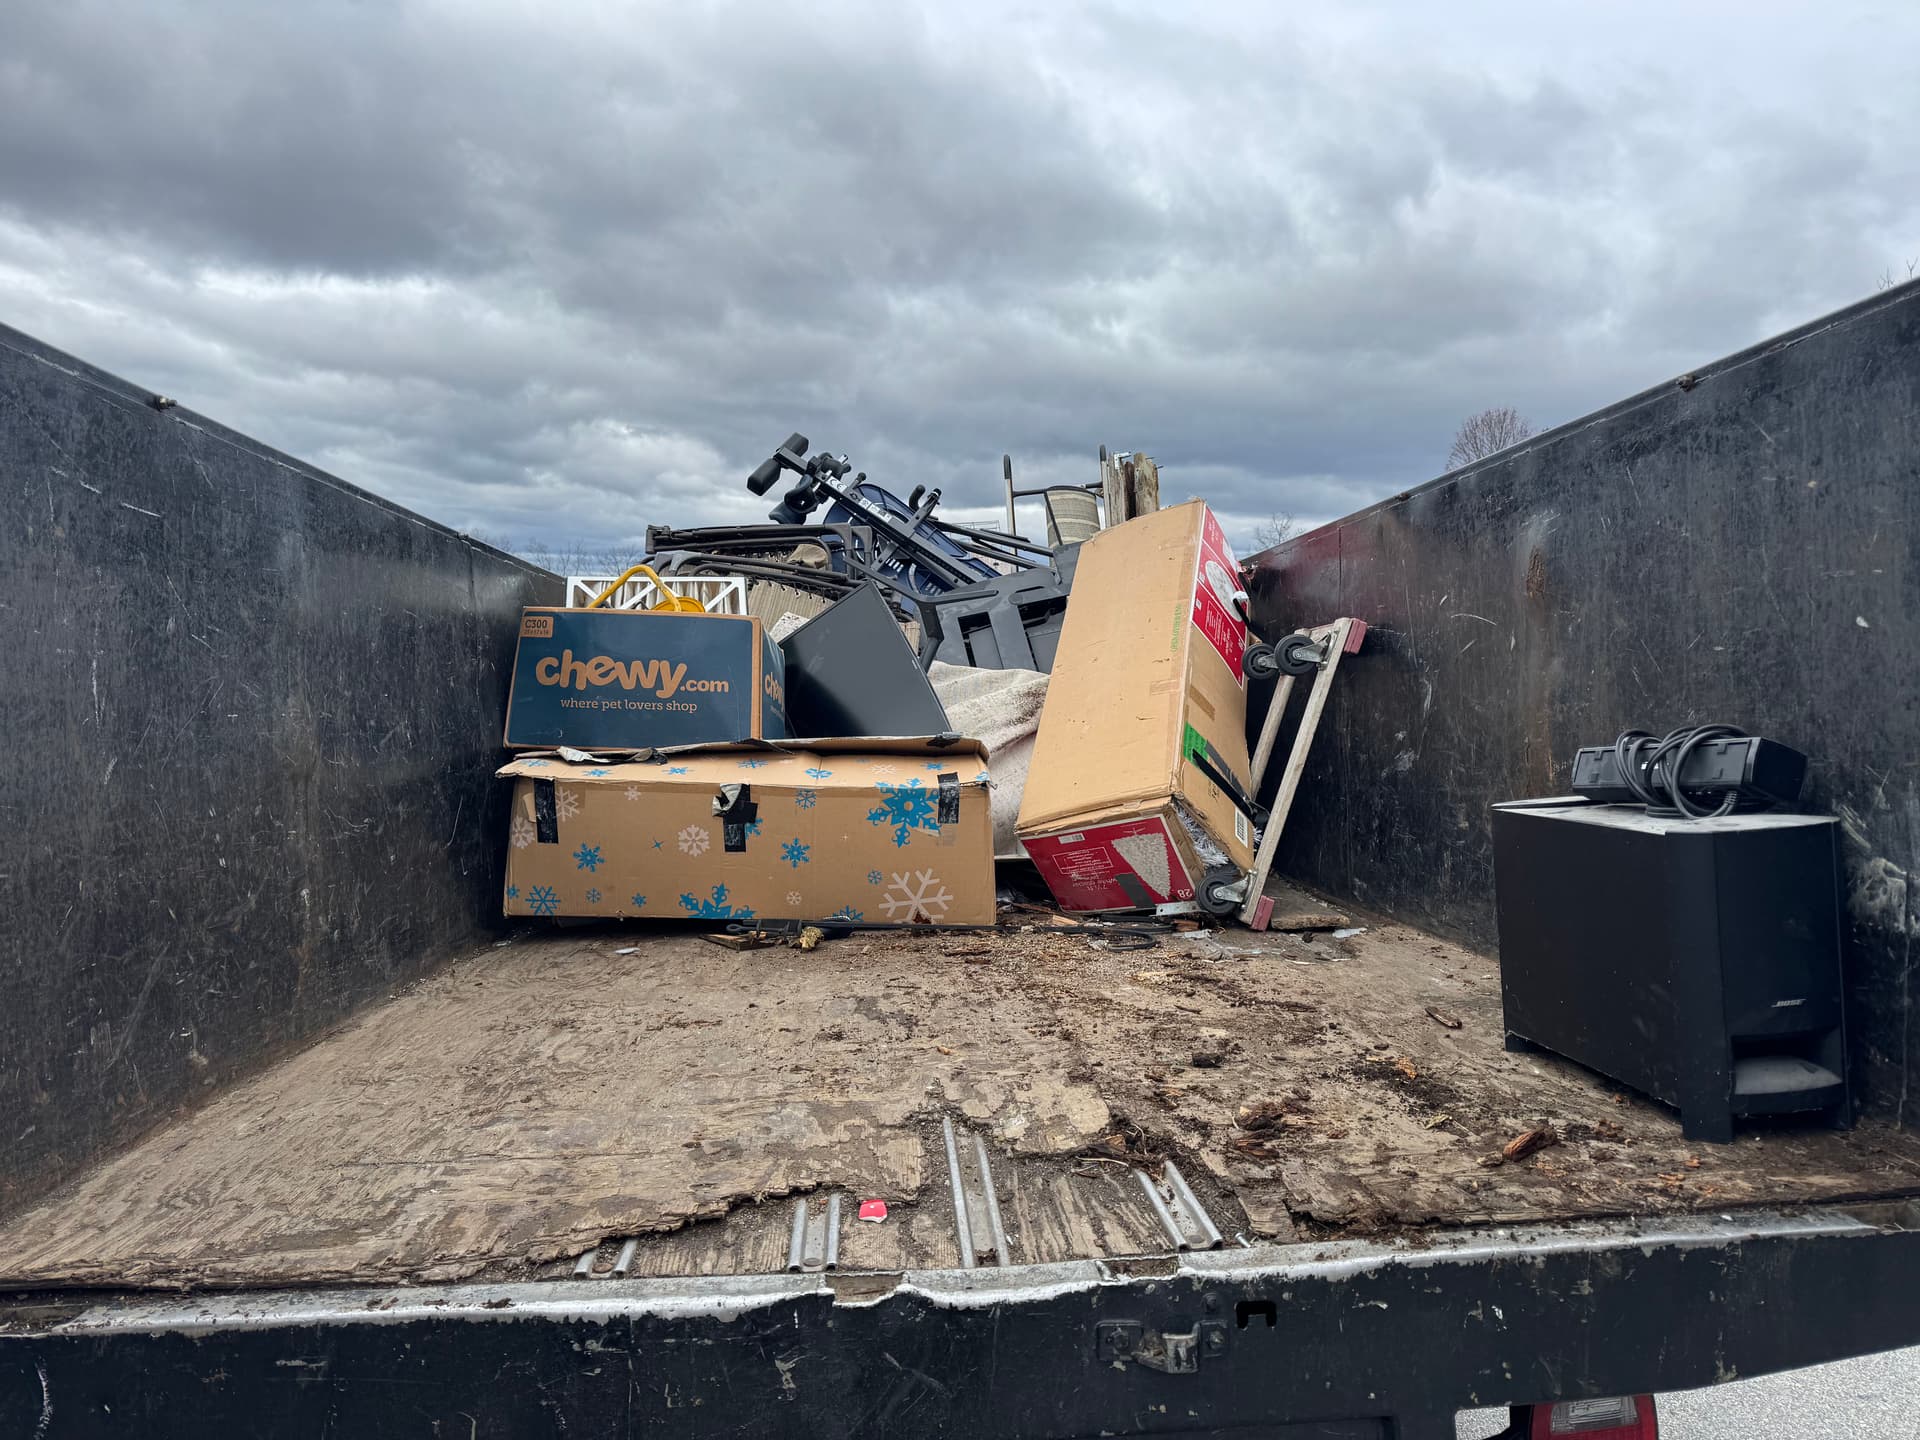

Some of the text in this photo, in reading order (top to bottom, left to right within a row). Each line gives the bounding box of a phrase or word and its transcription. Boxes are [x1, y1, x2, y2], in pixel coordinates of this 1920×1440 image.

[525, 619, 548, 629] C300
[535, 648, 729, 699] chewy.com
[560, 697, 698, 713] where pet lovers shop
